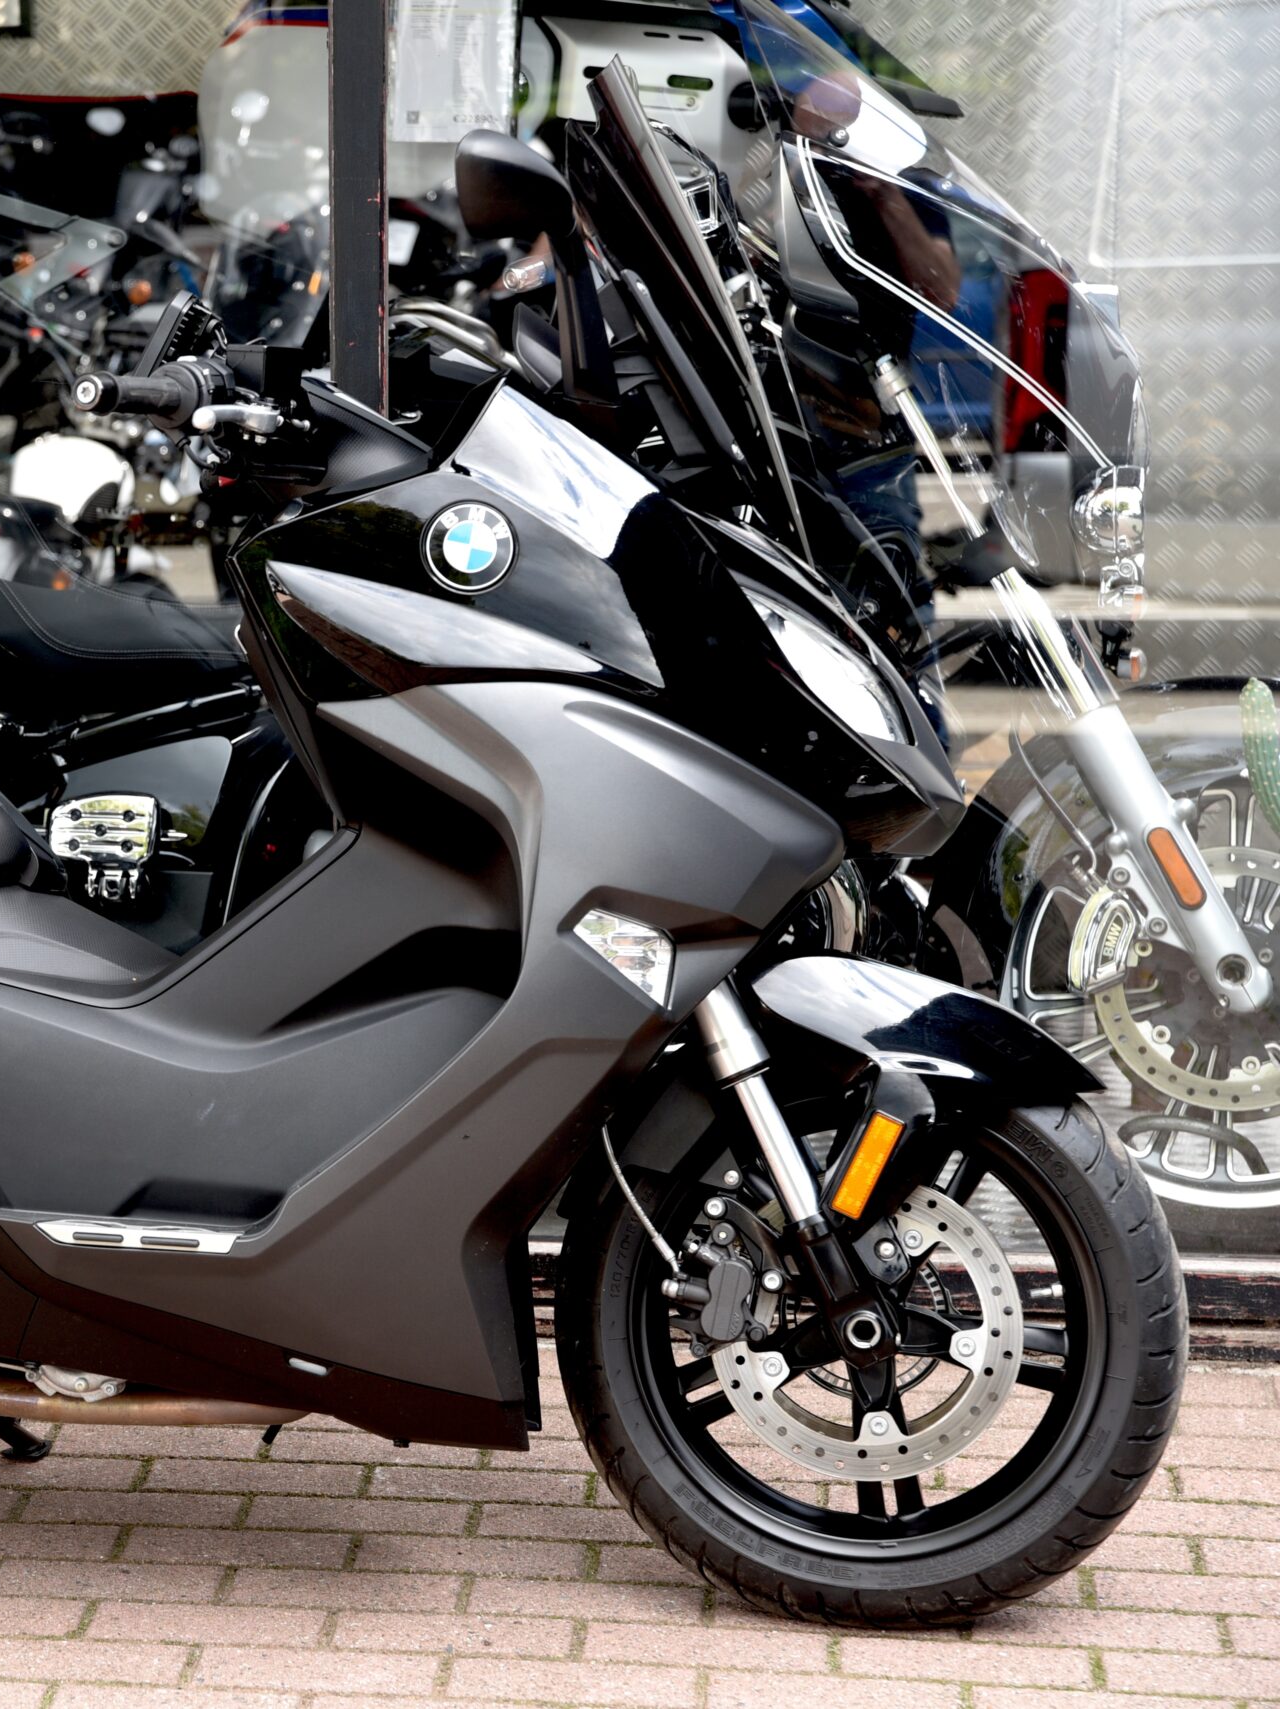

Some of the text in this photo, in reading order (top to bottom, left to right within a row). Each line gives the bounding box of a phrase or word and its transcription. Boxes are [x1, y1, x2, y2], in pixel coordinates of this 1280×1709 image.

[440, 506, 510, 540] BMW
[1102, 921, 1122, 958] BMW
[673, 1480, 858, 1582] FEELFREE
